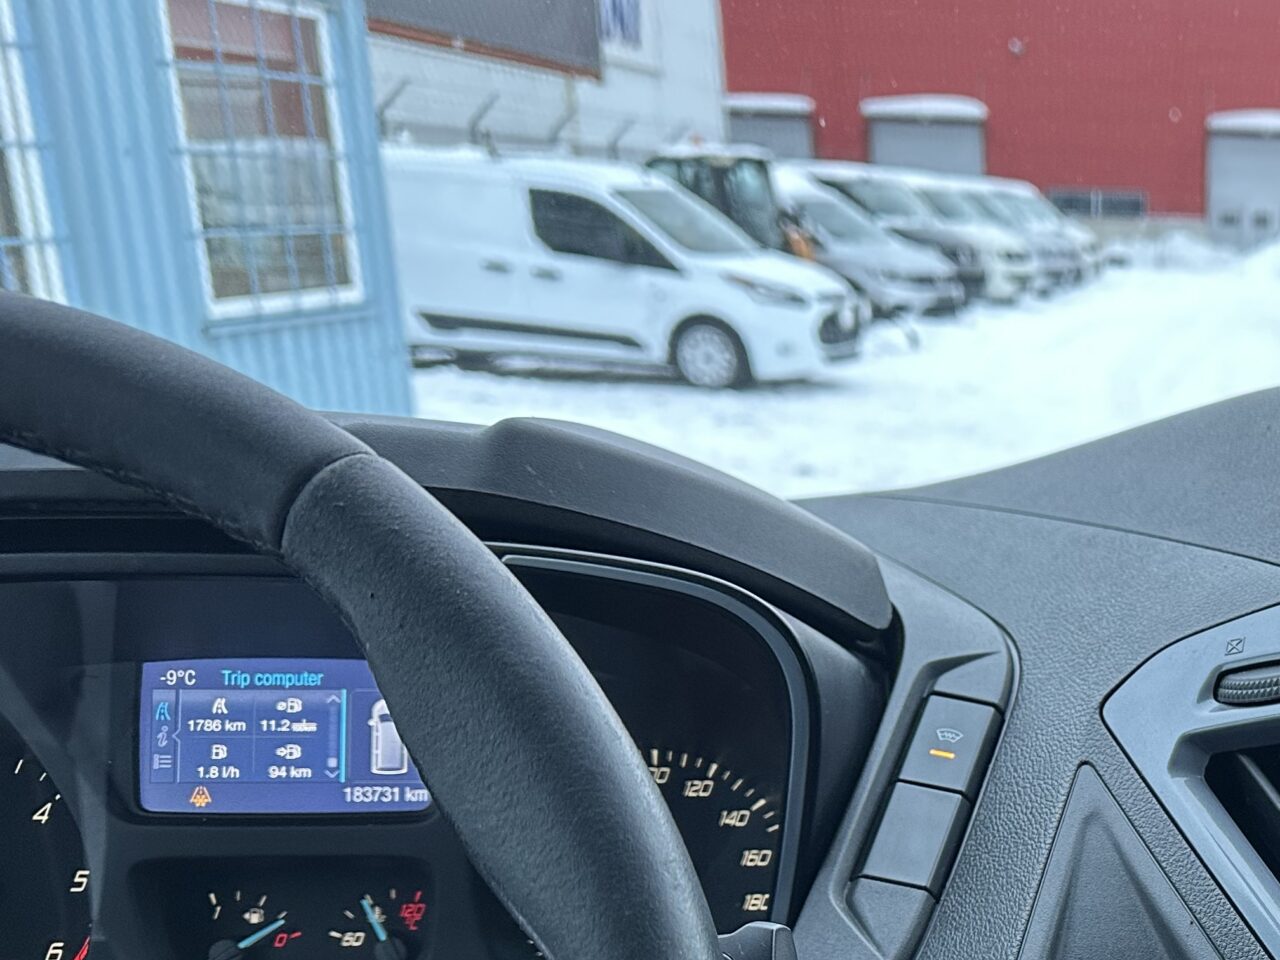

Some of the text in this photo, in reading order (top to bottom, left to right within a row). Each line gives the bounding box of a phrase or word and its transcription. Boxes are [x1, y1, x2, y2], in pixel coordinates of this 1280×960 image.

[159, 669, 196, 686] -9°C
[221, 669, 324, 687] Trip computer
[187, 719, 246, 733] 1786 km
[260, 718, 290, 732] 11.2
[197, 765, 219, 779] 1.8
[268, 765, 312, 779] 94 km
[342, 786, 428, 803] 183731 km
[683, 779, 714, 797] 120
[32, 802, 52, 824] 4
[719, 809, 750, 827] 140
[740, 849, 773, 867] 160
[69, 869, 91, 893] 5
[272, 932, 288, 948] 0
